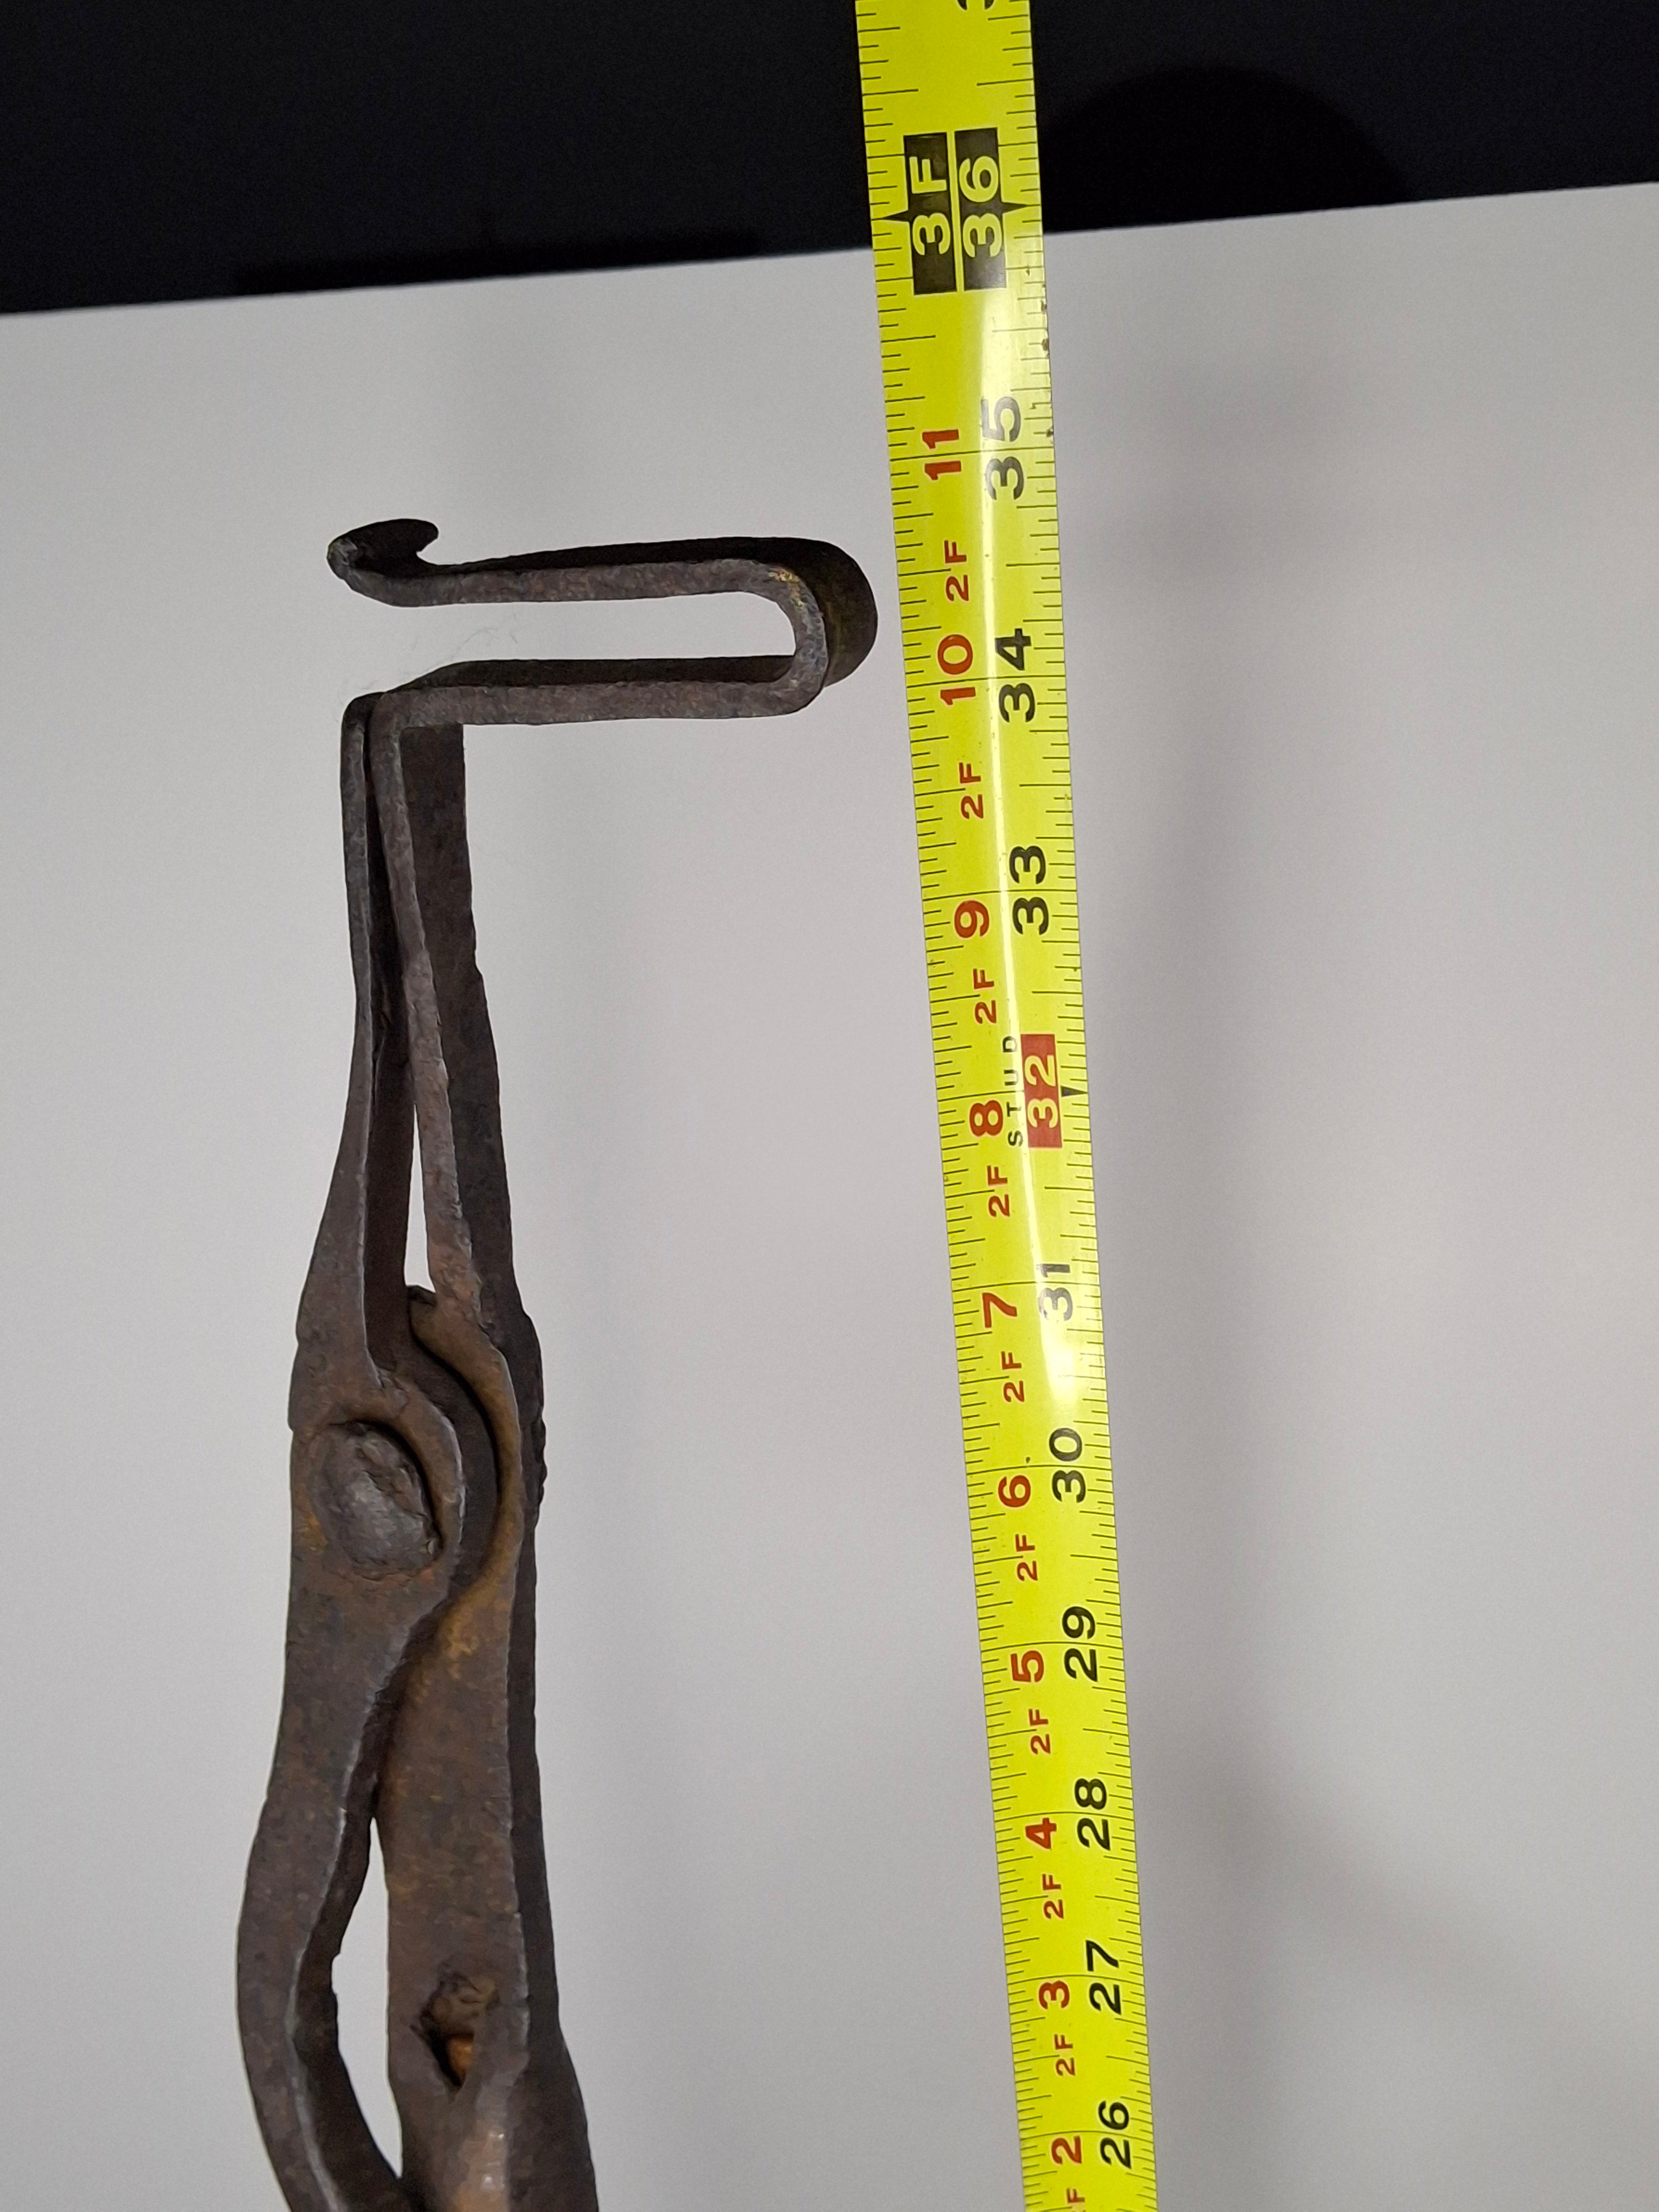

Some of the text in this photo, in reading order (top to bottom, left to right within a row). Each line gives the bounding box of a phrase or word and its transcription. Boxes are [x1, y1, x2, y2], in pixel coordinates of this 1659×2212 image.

[959, 156, 1004, 258] 36
[922, 429, 961, 480] 11
[981, 396, 1024, 500] 35
[937, 634, 976, 705] 10
[995, 628, 1035, 723] 34
[954, 900, 989, 938] 9
[1009, 845, 1049, 935] 33
[969, 1099, 1003, 1137] 8
[1002, 1036, 1023, 1147] STUD
[1024, 1054, 1059, 1129] 32
[982, 1292, 1018, 1328] 7
[1037, 1264, 1073, 1321] 31
[998, 1474, 1031, 1507] 6
[1049, 1427, 1086, 1503] 30
[1011, 1650, 1044, 1683] 5
[1062, 1606, 1098, 1682] 29
[1025, 1817, 1057, 1849] 4
[1074, 1778, 1110, 1851] 28
[1038, 1980, 1070, 2010] 3
[1085, 1939, 1121, 2015] 27
[1051, 2135, 1082, 2165] 2
[1098, 2100, 1132, 2169] 26
